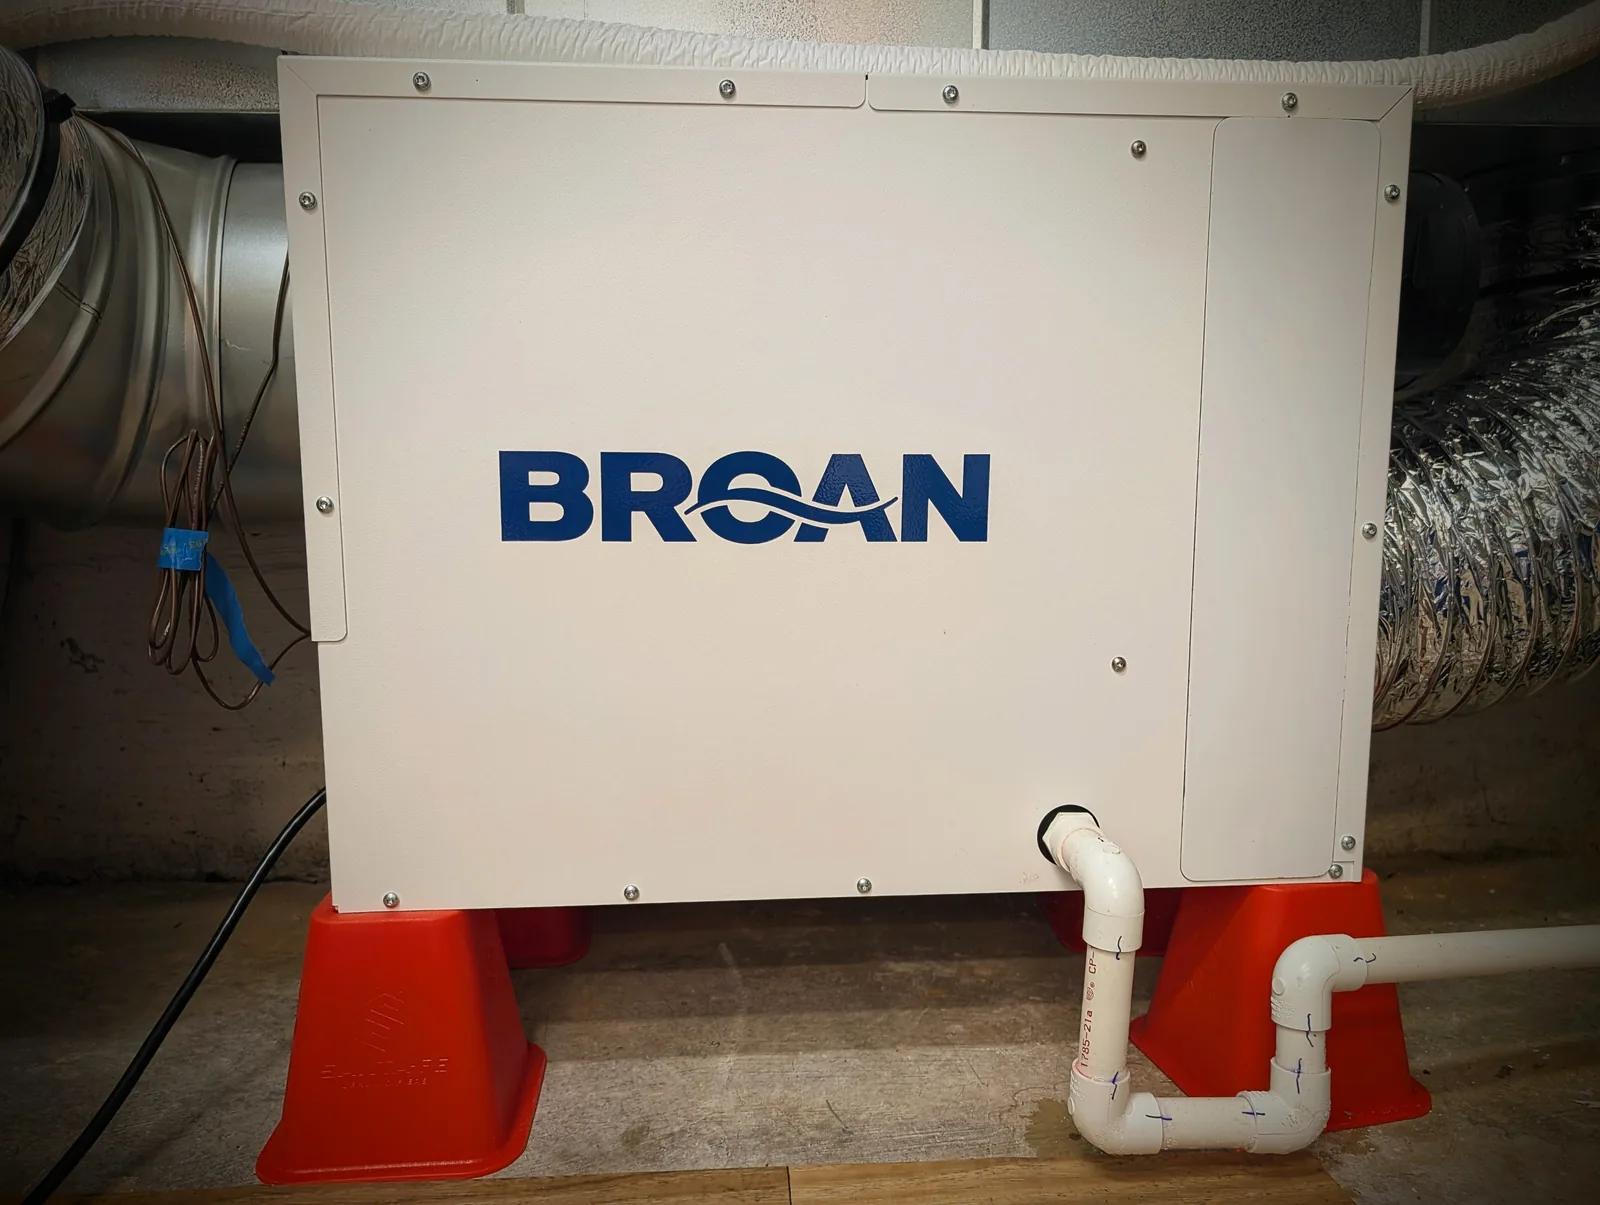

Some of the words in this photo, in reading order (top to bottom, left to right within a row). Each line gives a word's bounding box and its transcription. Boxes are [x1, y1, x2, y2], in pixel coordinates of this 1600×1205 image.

[499, 450, 991, 544] BROAN
[1080, 1010, 1093, 1068] 1785-21a
[1088, 946, 1097, 975] CP-
